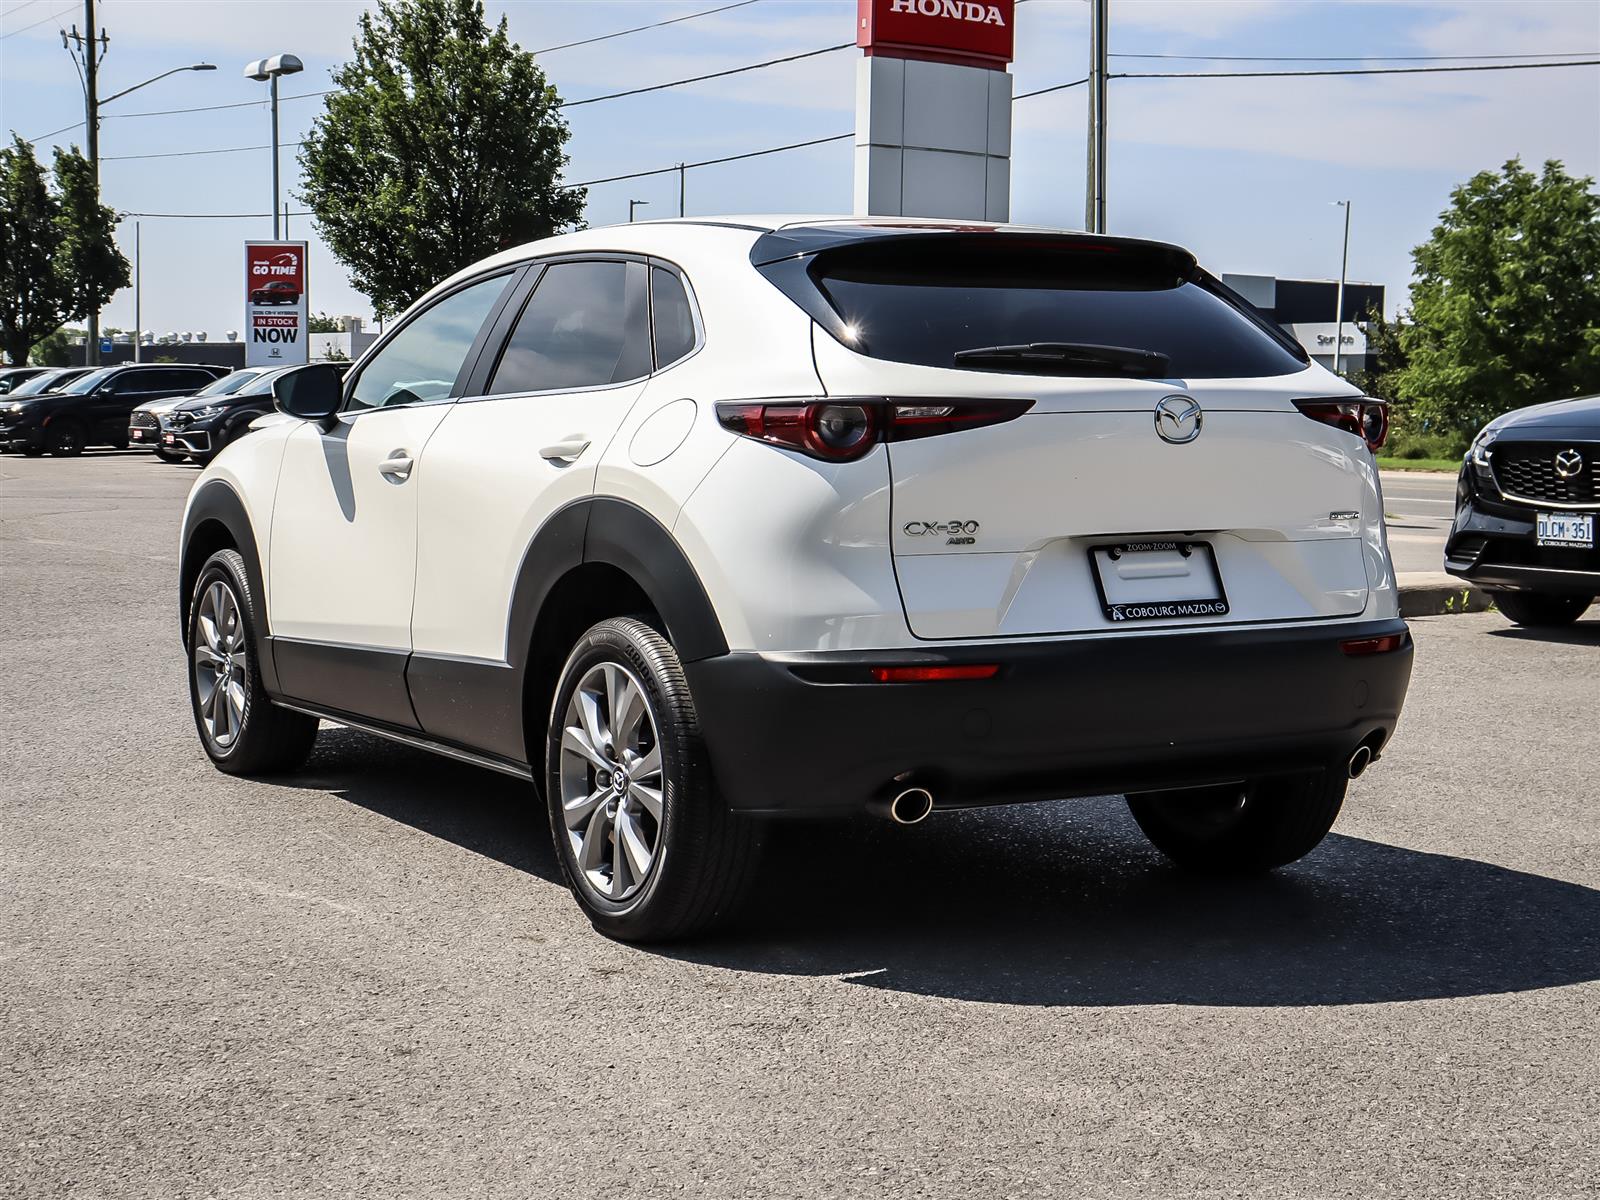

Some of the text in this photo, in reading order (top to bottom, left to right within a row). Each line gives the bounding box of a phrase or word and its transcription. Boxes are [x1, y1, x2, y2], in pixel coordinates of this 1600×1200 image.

[890, 0, 1005, 26] HONDA
[253, 266, 297, 275] GO TIME
[267, 318, 294, 326] STOCK
[253, 328, 298, 343] NOW
[1317, 335, 1355, 344] Serce
[903, 520, 979, 536] CX-30
[1538, 521, 1591, 540] DLCM 351
[1125, 603, 1216, 618] COBOURG MAZDA
